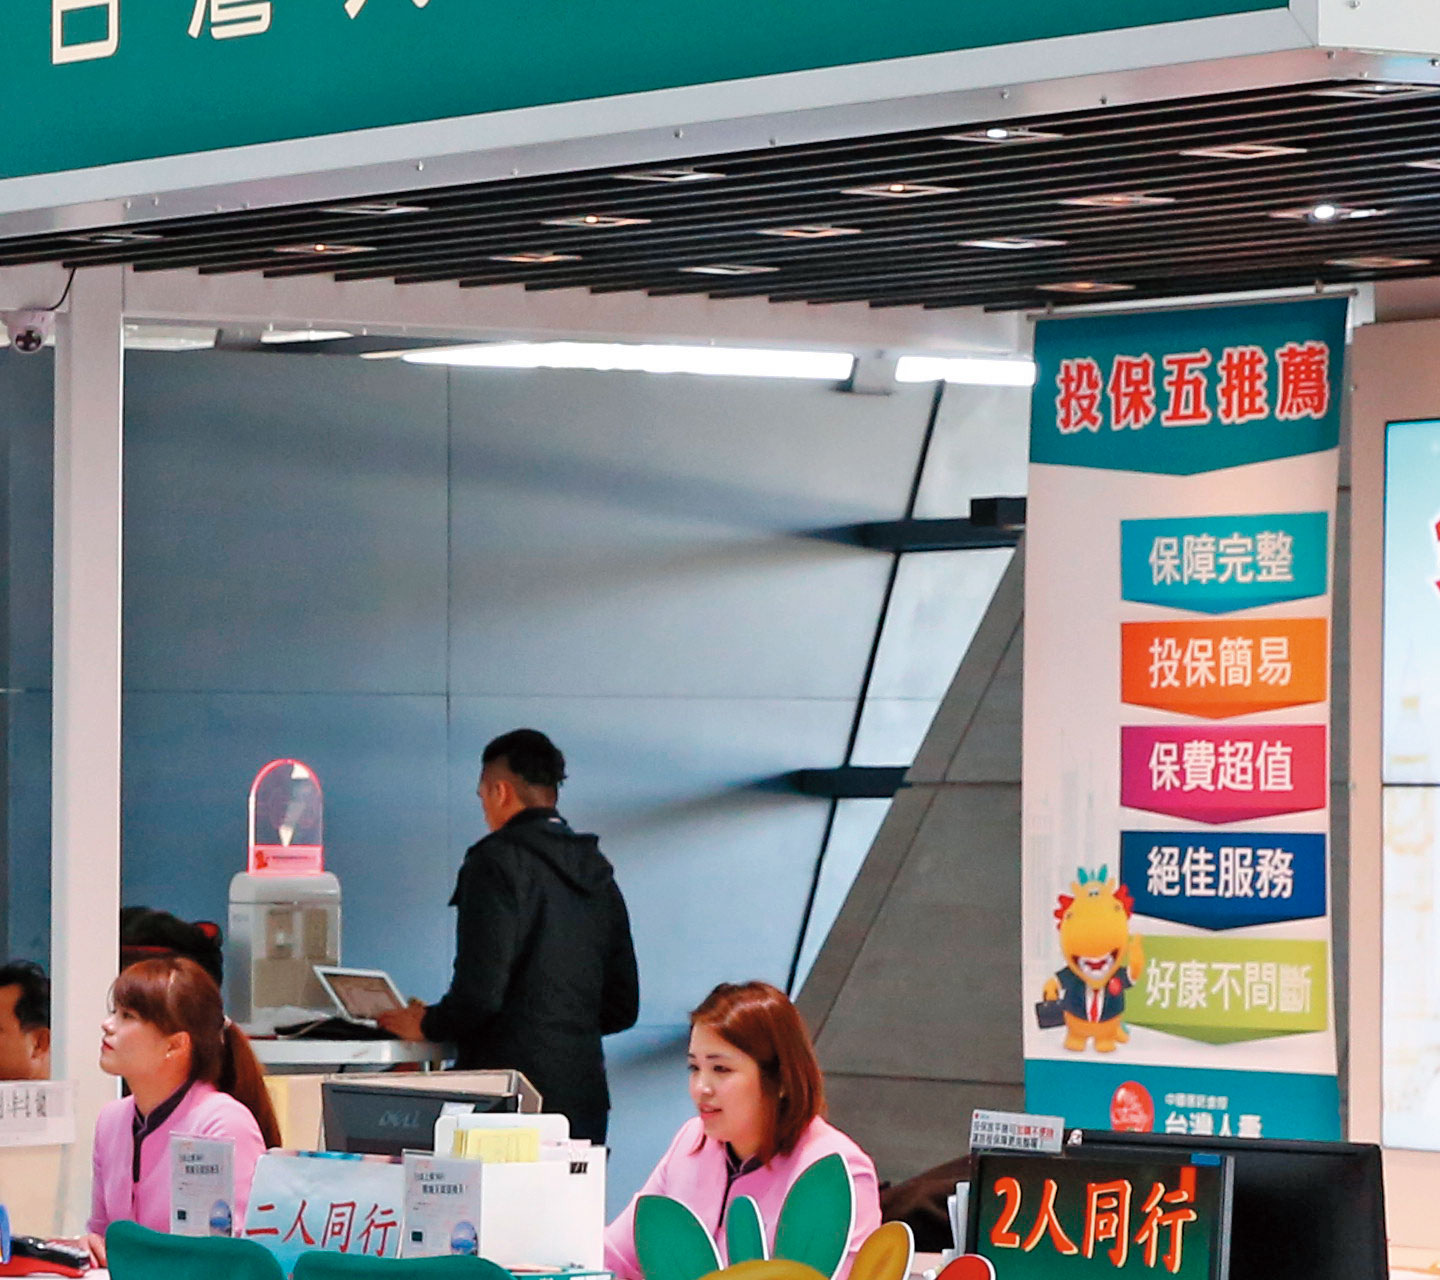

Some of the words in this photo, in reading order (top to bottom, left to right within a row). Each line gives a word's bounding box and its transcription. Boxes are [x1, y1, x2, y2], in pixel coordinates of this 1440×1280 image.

[1056, 340, 1330, 434] 投保五推薦
[1148, 531, 1294, 586] 保障完整
[1148, 636, 1292, 689] 投保簡易
[1148, 740, 1294, 792] 保費超值
[1146, 846, 1295, 899] 絕佳服務
[1145, 958, 1311, 1014] 好康不間斷
[244, 1199, 399, 1257] 二人同行
[990, 1174, 1199, 1274] 2人同行
